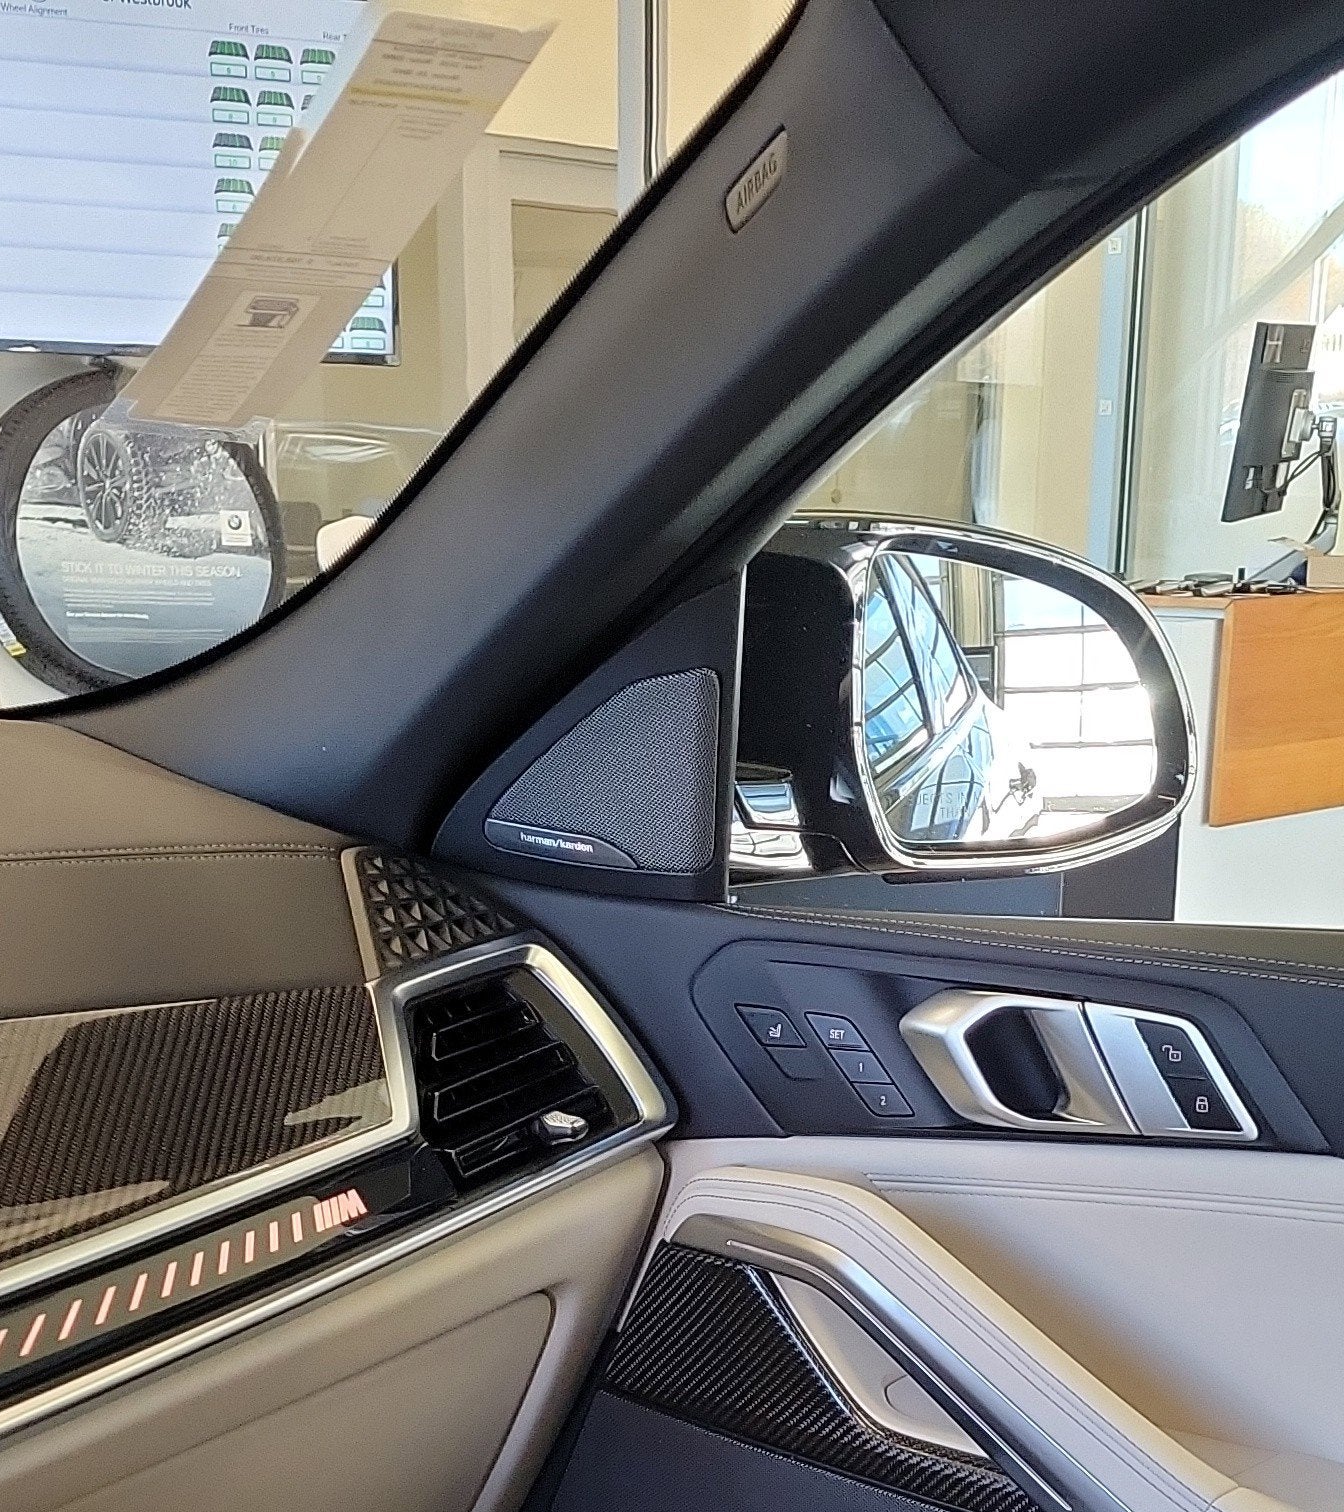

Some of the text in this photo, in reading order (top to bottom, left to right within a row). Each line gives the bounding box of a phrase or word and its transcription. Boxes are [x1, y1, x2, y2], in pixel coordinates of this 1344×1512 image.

[736, 152, 778, 215] AIRBAG
[61, 561, 92, 574] STICK
[93, 563, 104, 575] IT
[109, 563, 123, 575] TO
[124, 563, 169, 577] WINTER
[170, 565, 193, 577] THIS
[520, 831, 594, 854] harman/kardon
[829, 1029, 845, 1041] SET
[859, 1062, 864, 1072] 1
[880, 1095, 886, 1106] 2
